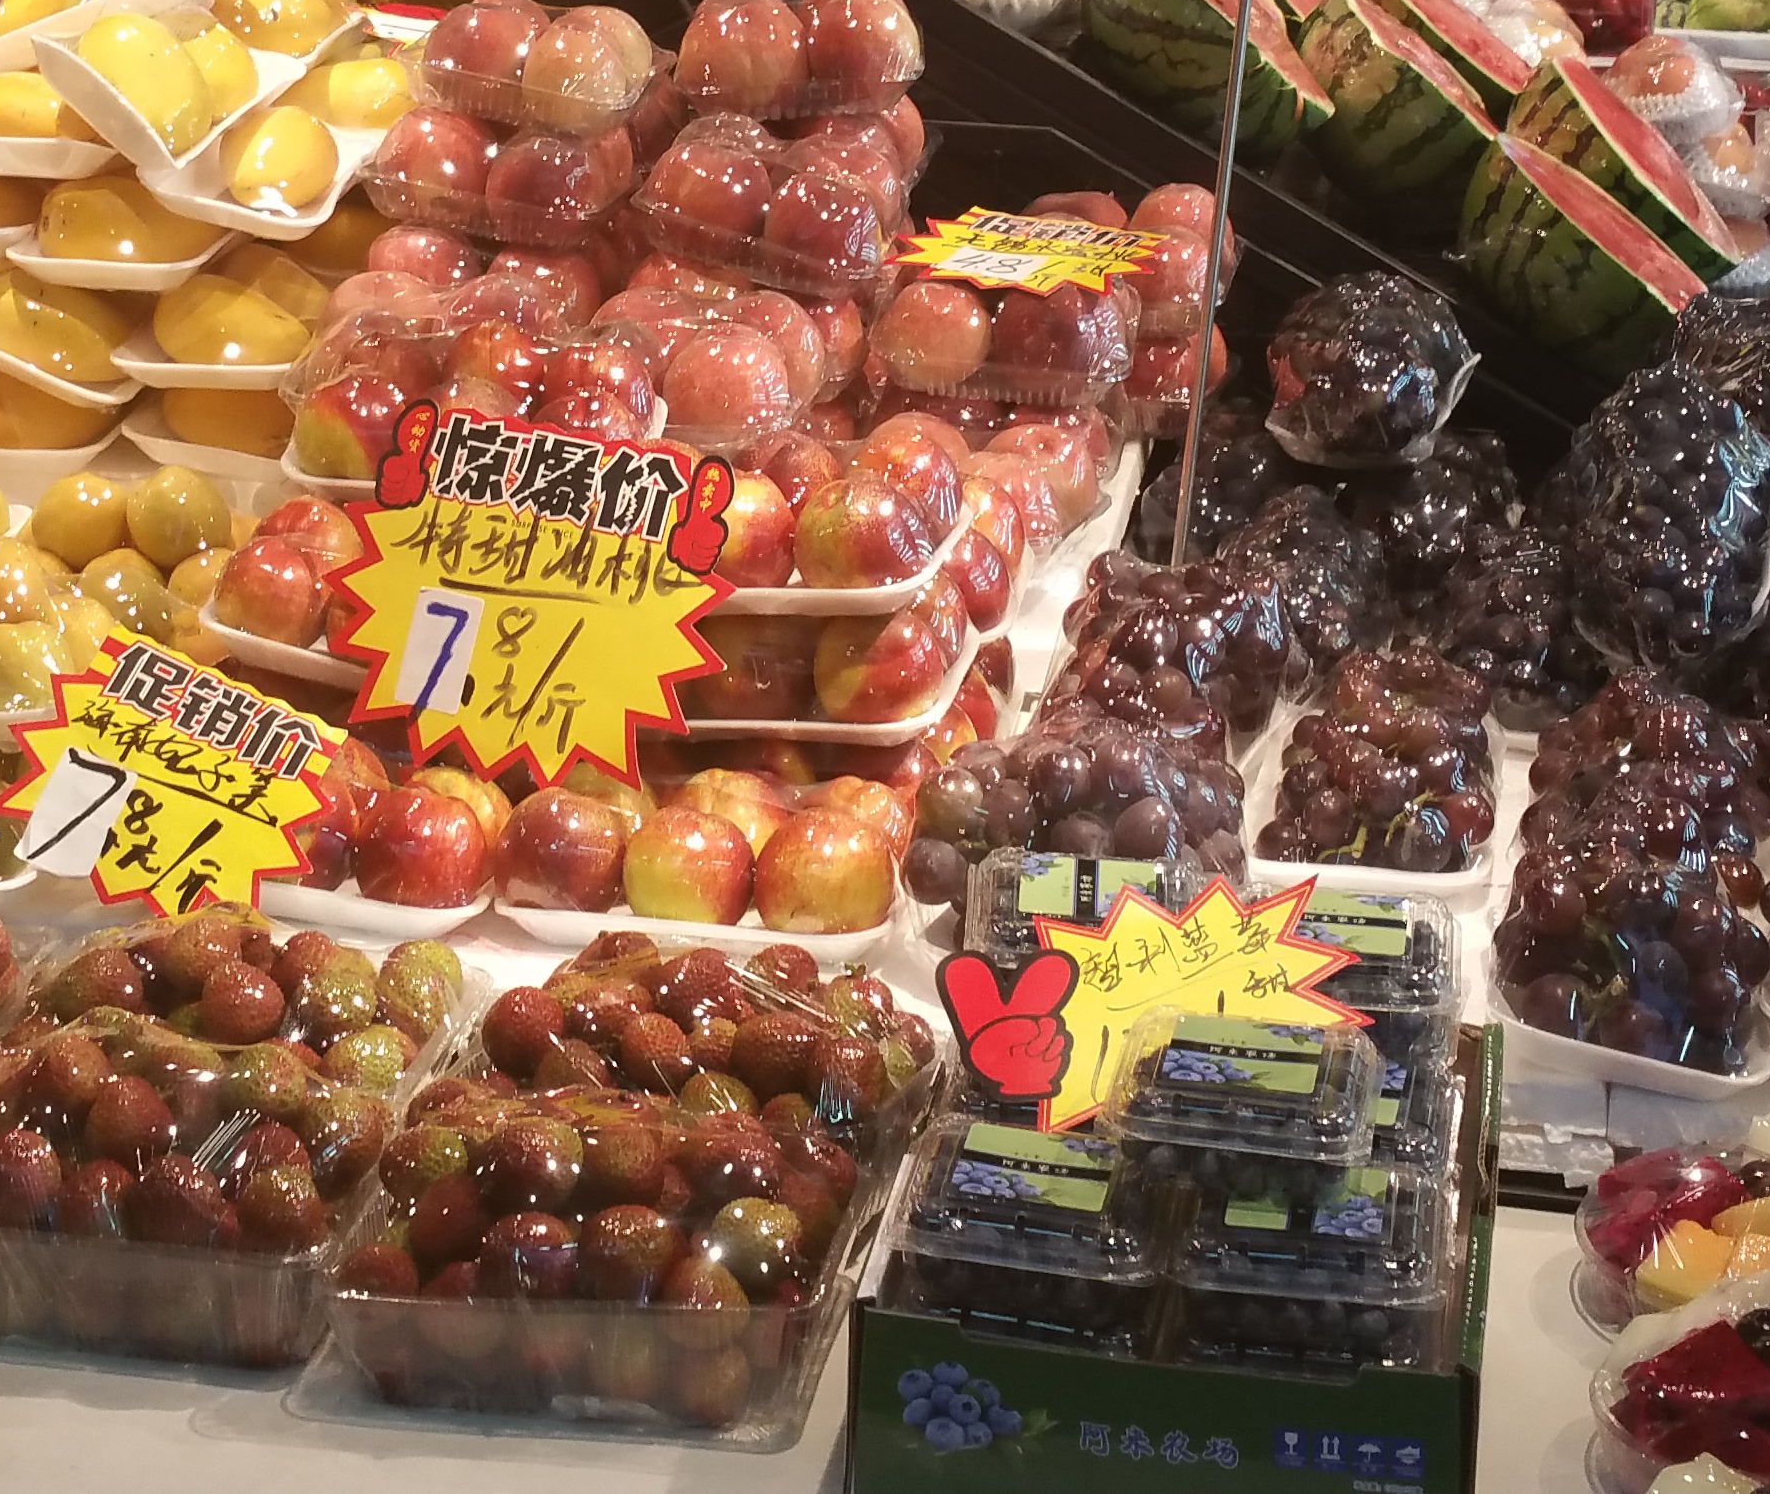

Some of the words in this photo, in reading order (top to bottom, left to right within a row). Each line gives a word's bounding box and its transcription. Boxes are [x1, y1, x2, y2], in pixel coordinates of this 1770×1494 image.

[431, 412, 688, 543] 惊爆价
[103, 641, 325, 780] 促销价
